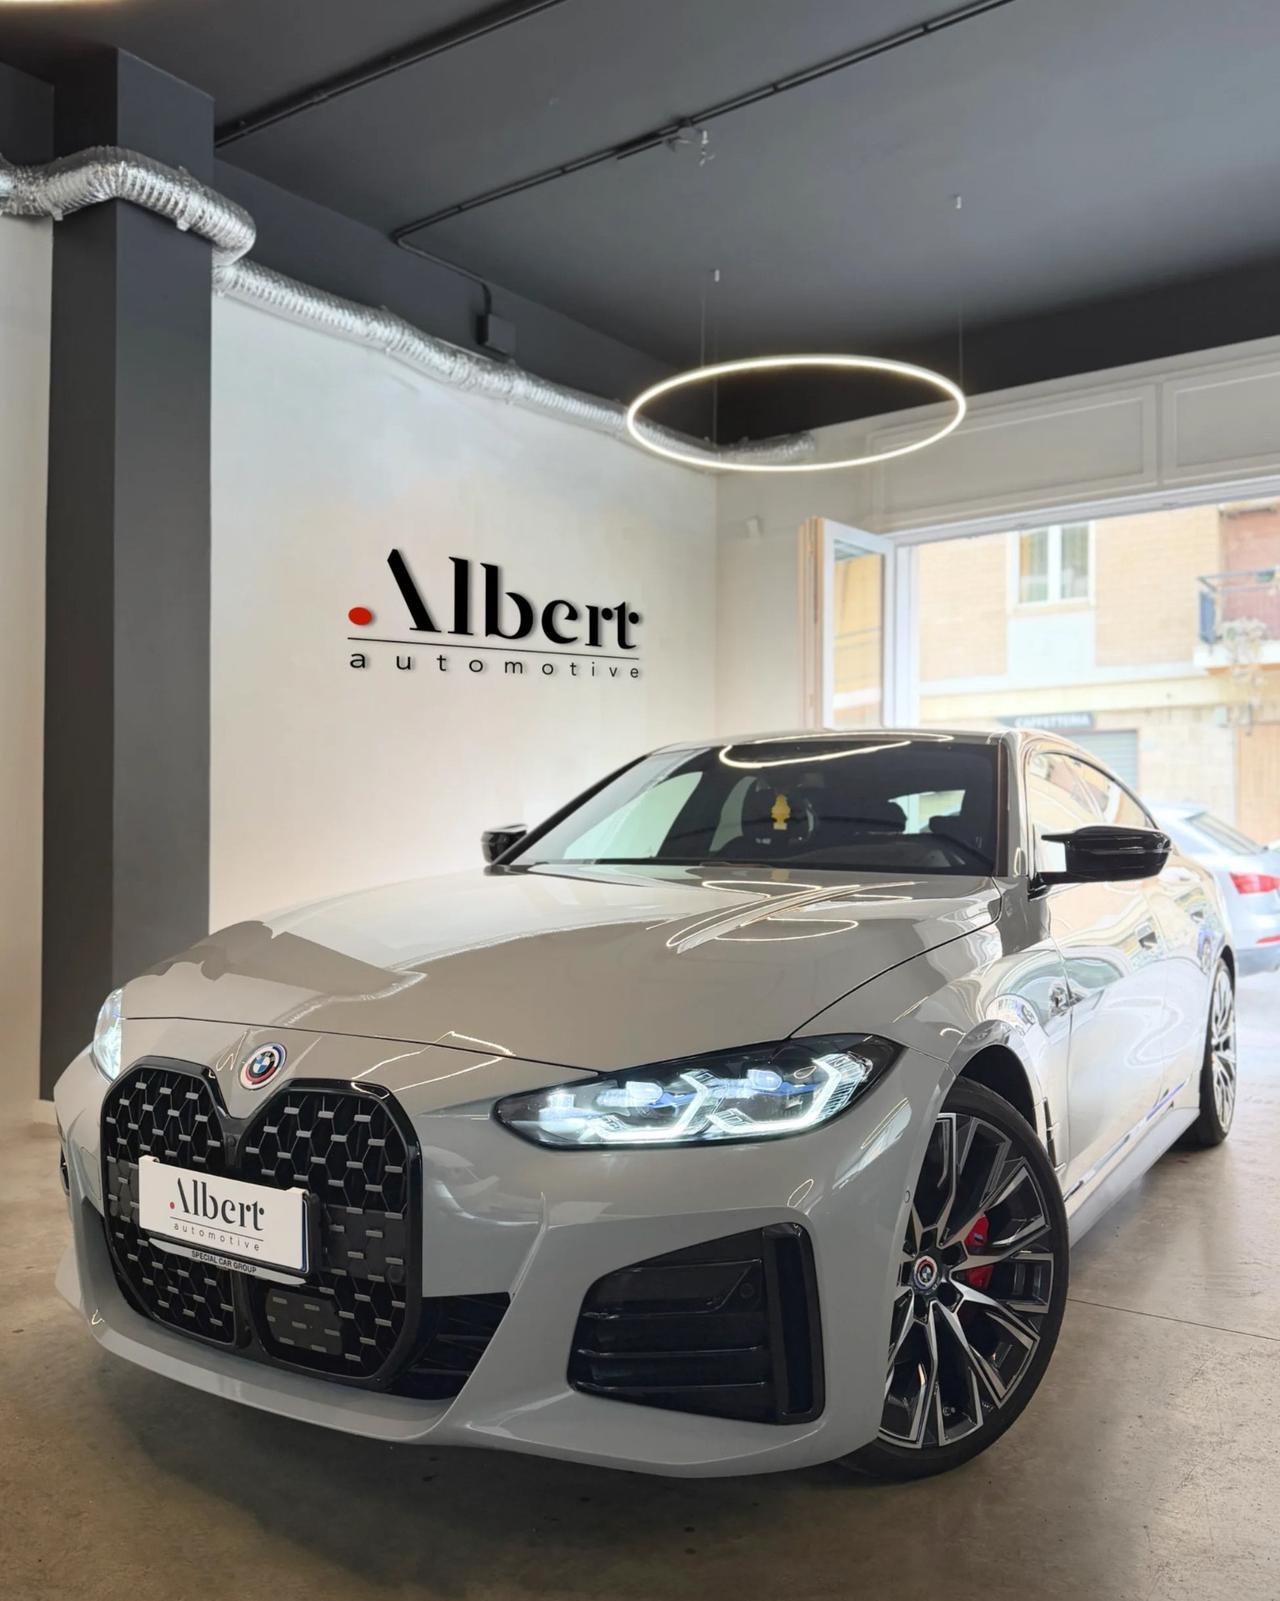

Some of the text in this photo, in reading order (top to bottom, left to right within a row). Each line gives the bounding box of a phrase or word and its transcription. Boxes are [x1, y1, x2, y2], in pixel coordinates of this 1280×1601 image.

[386, 548, 640, 649] Albert
[349, 652, 640, 678] automotive
[176, 1177, 265, 1231] Albert
[173, 1222, 259, 1252] automotive
[191, 1250, 257, 1274] SPECIAL CAR GROUP
